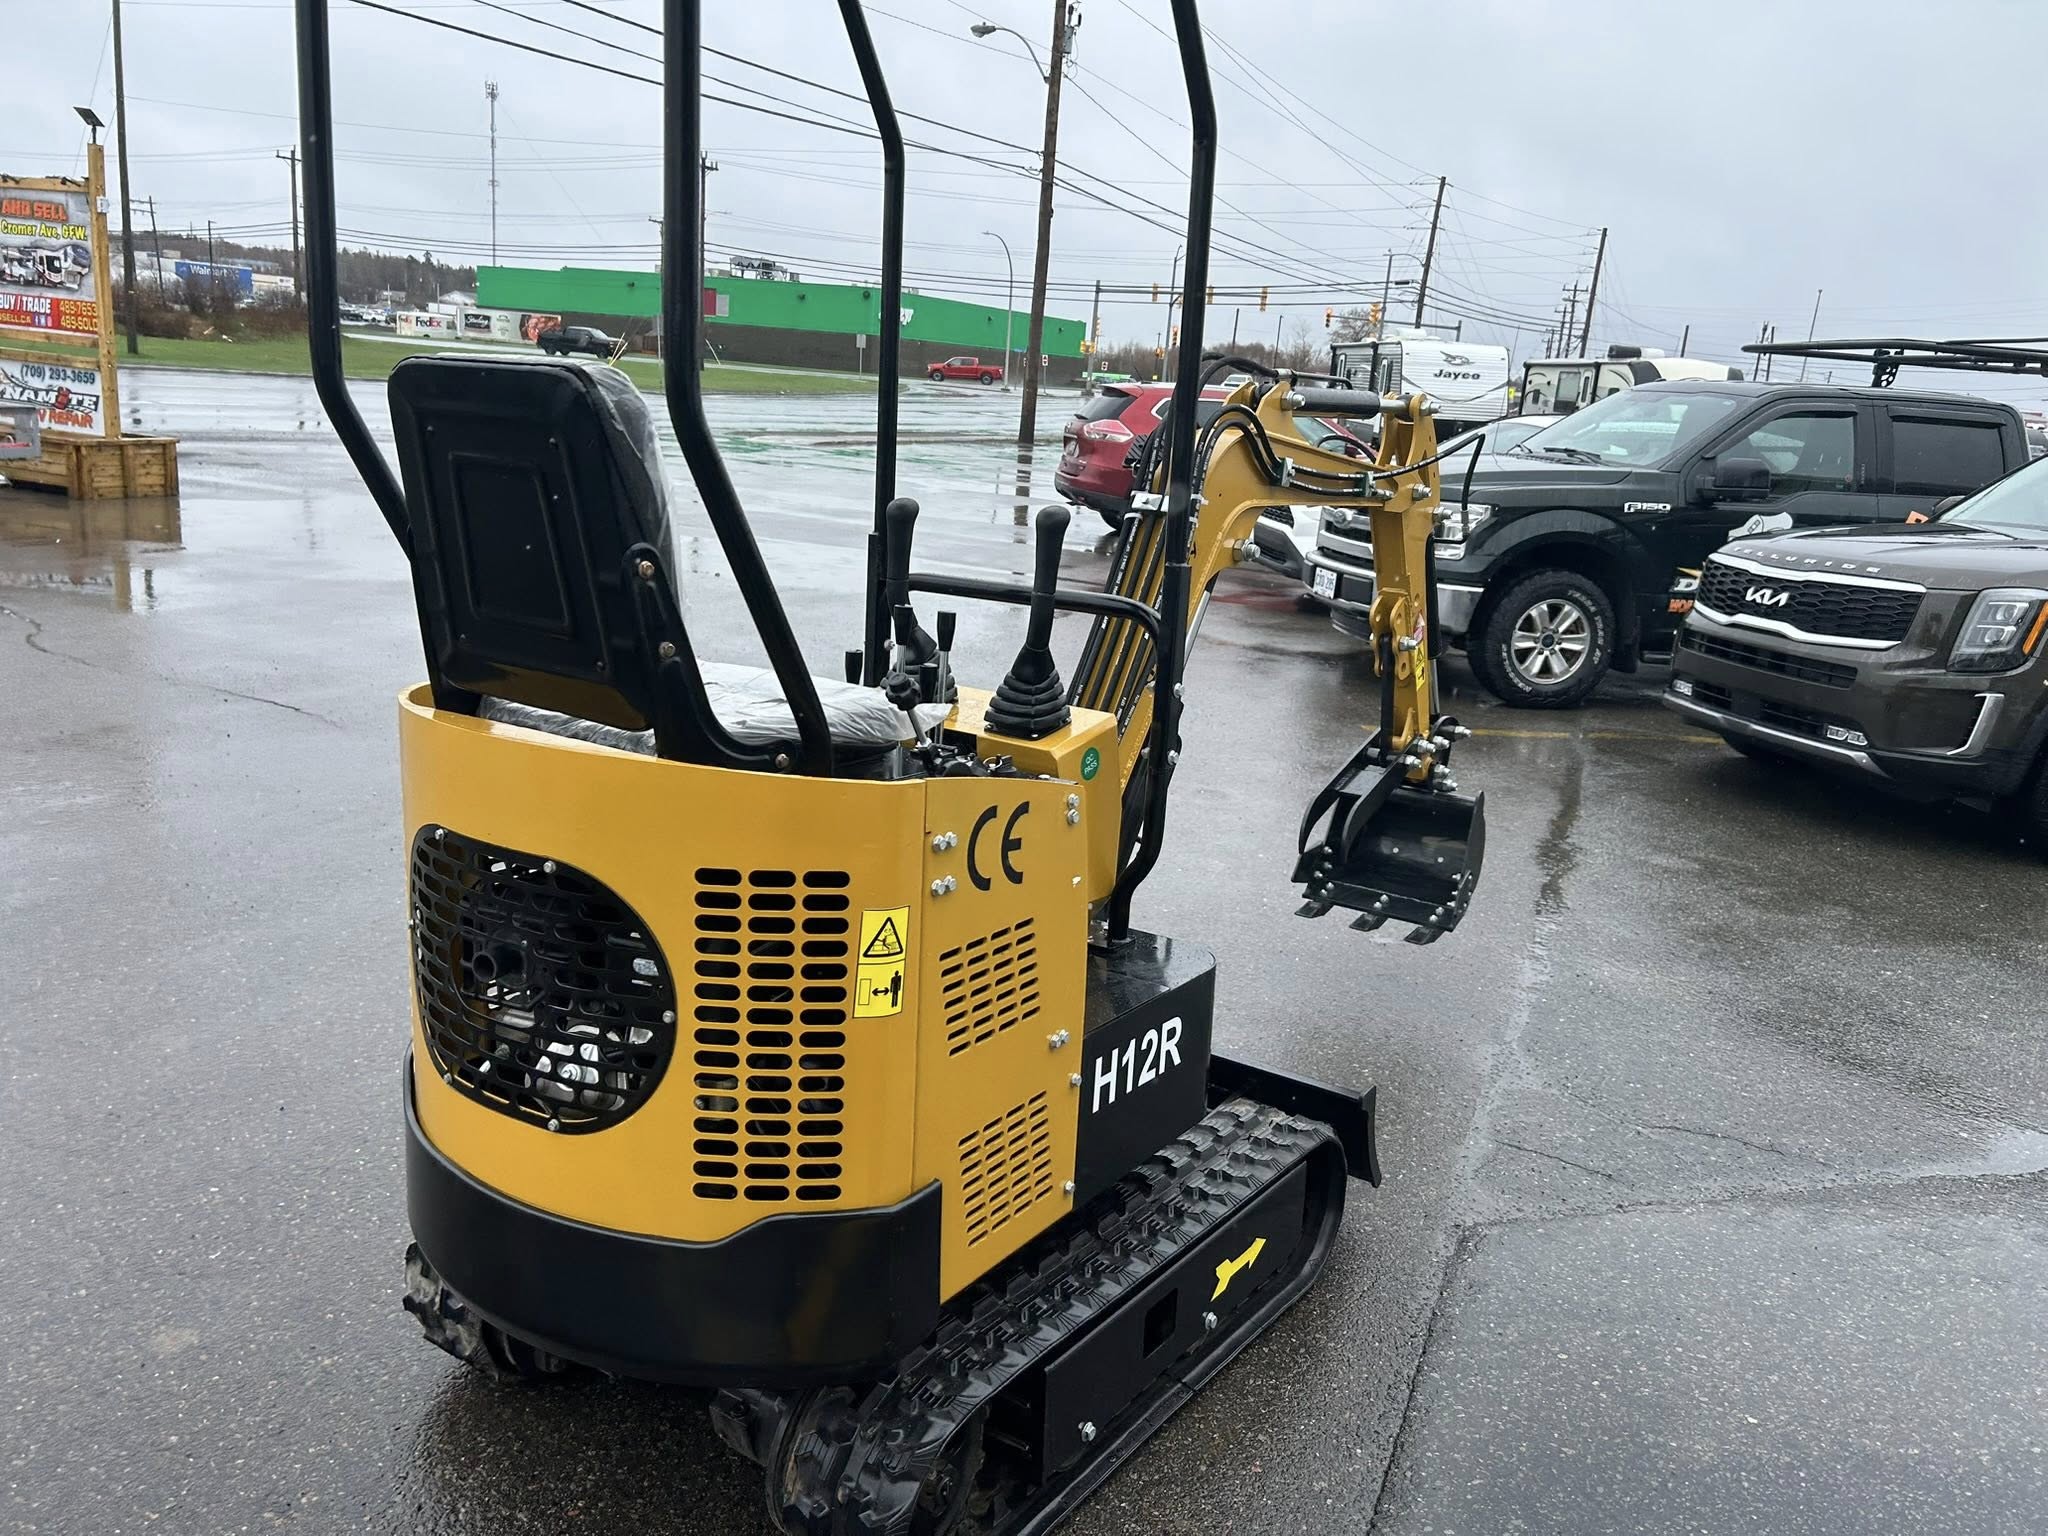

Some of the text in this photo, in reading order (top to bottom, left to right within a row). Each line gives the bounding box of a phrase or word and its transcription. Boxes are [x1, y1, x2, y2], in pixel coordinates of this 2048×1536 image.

[33, 201, 67, 221] SELL
[1, 219, 37, 236] Cromer
[22, 296, 51, 314] TRADE
[59, 300, 97, 316] 489-7653
[0, 313, 31, 324] SELL.CA
[415, 315, 442, 328] FedEx
[20, 364, 96, 385] (709) 293-3659
[1433, 369, 1480, 380] Jayco
[49, 409, 94, 429] REPAIR
[1733, 546, 1881, 574] TELLURIDE
[1745, 586, 1792, 608] KIA
[967, 801, 1030, 891] CE
[1092, 1016, 1183, 1114] H12R
